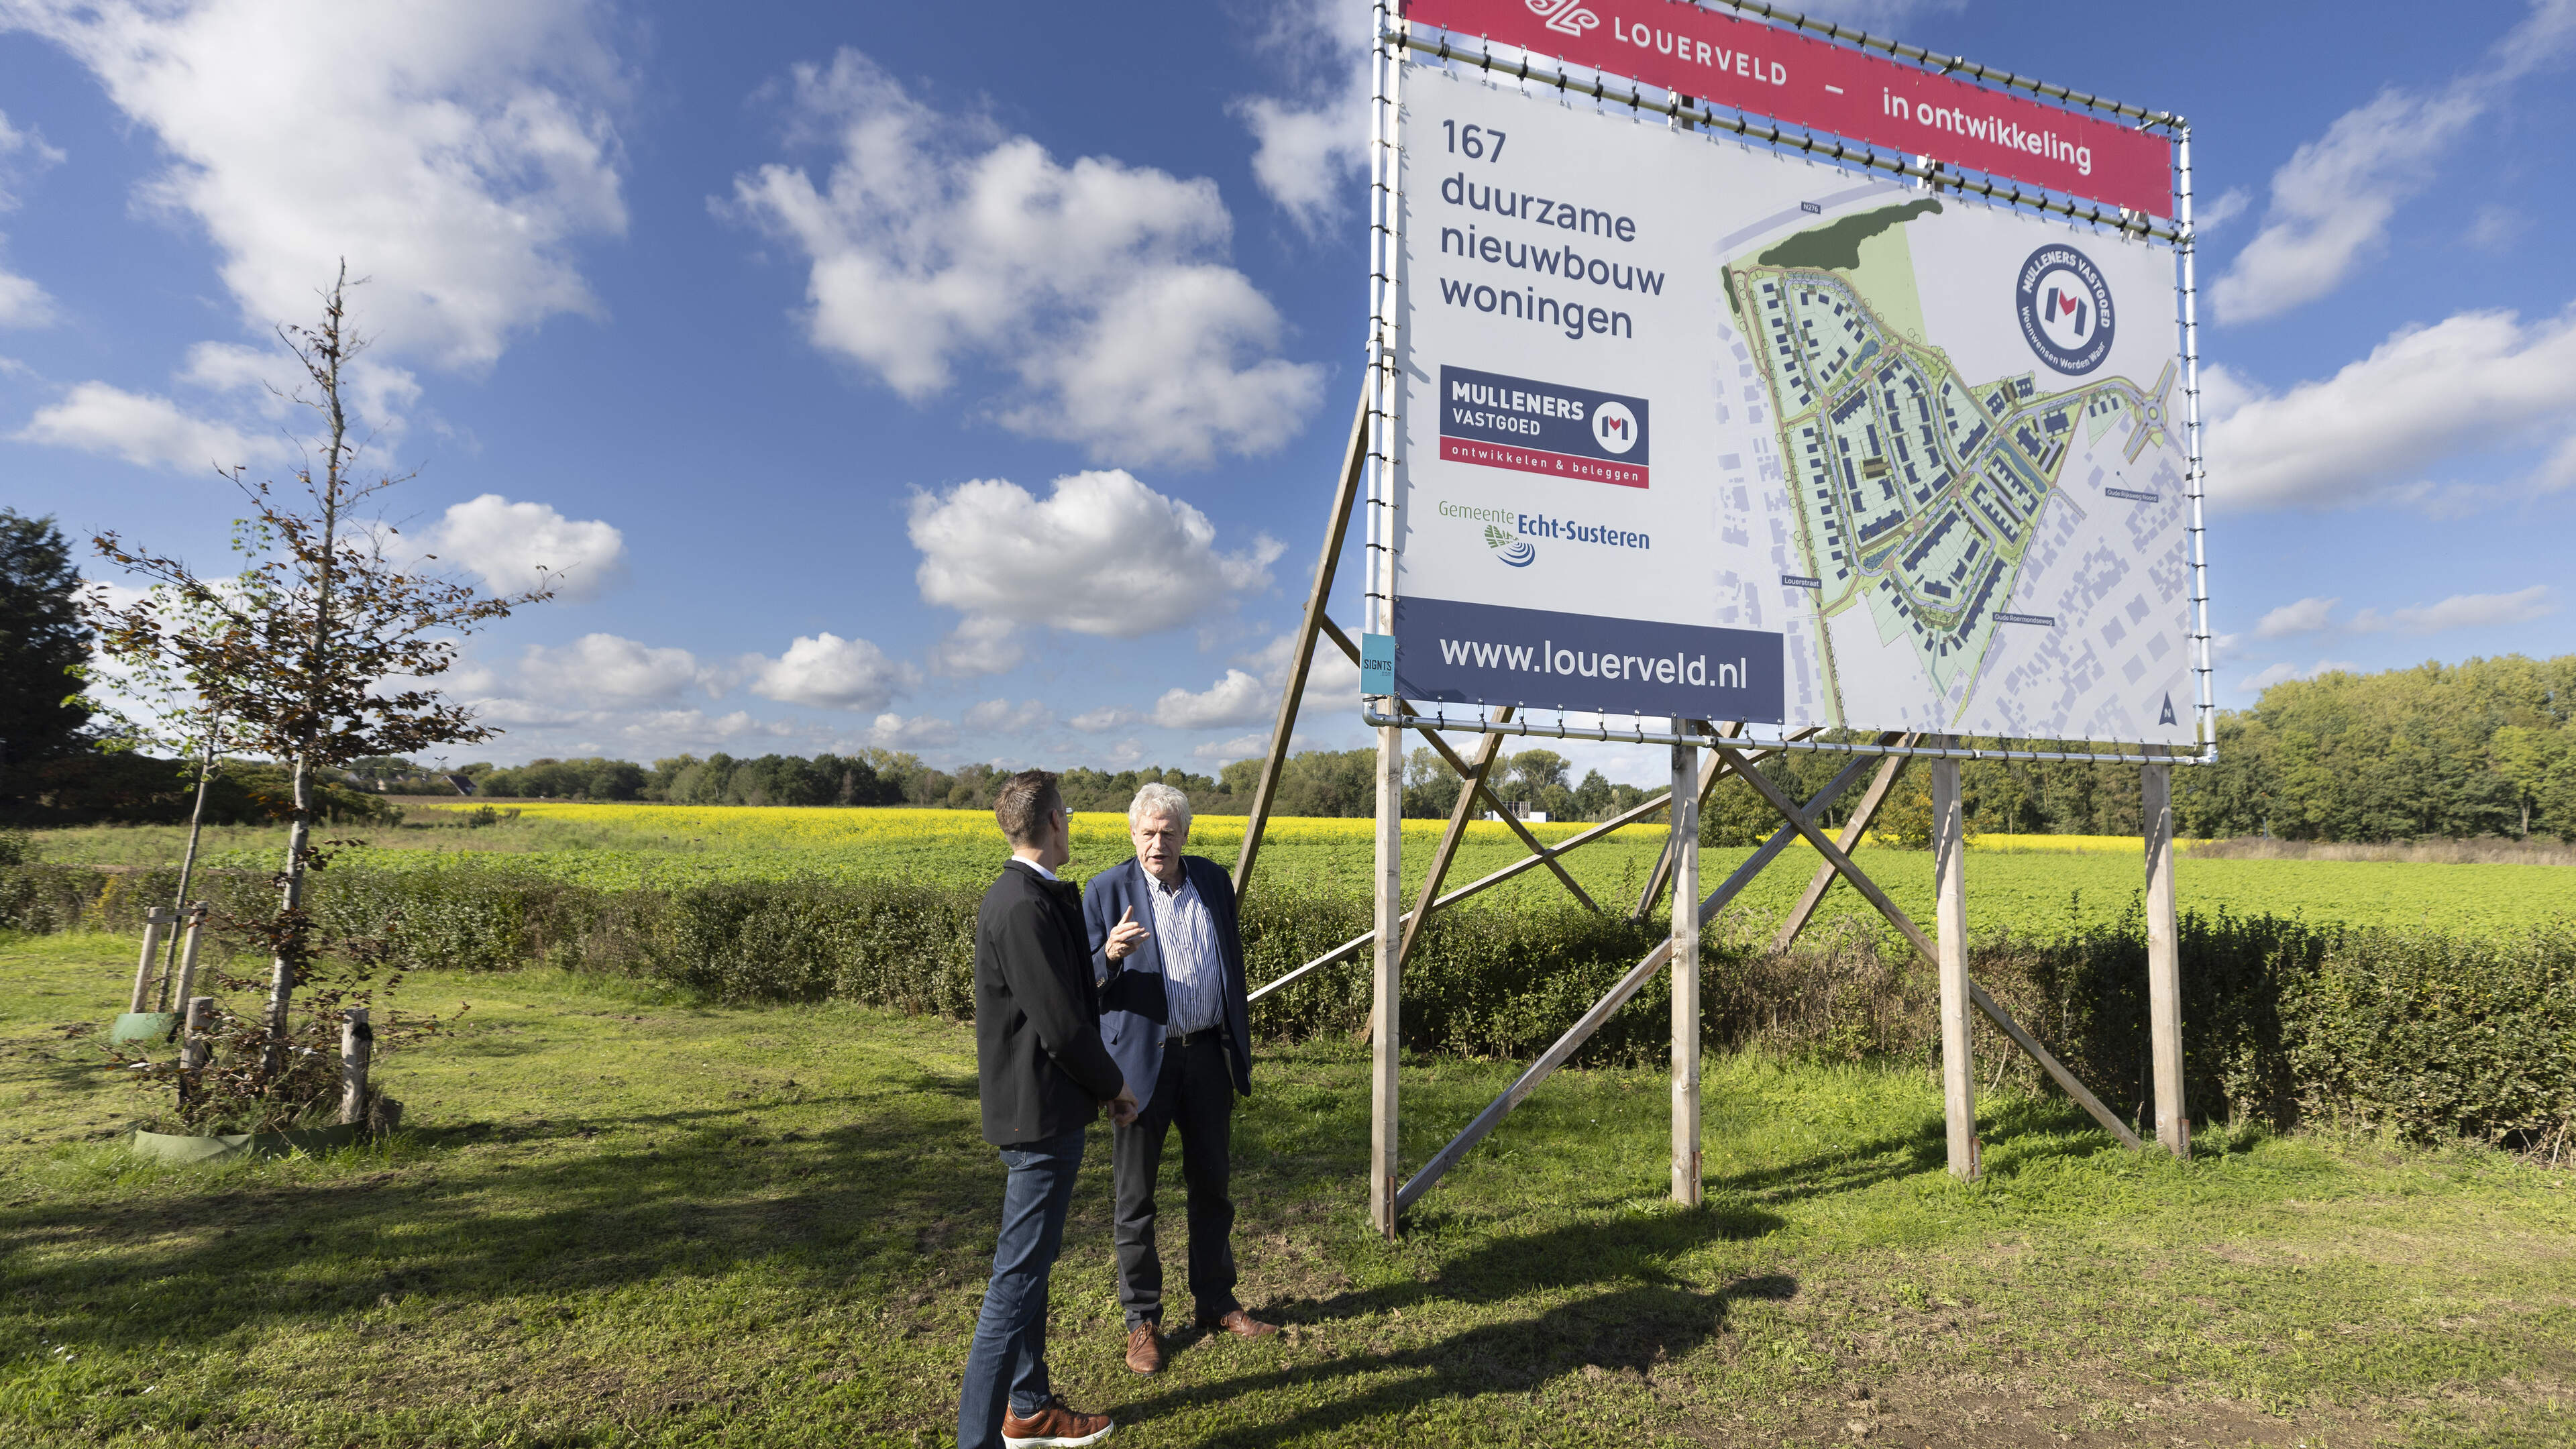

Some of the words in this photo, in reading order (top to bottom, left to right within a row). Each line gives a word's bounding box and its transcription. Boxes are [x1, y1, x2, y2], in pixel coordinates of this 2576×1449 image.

[1615, 17, 1786, 85] LOUERVELD
[1884, 87, 1909, 120] in
[1917, 103, 2092, 176] ontwikkeling
[1443, 119, 1506, 163] 167
[1441, 172, 1635, 241] duurzame
[1803, 203, 1819, 213] N276
[1442, 224, 1665, 296] nieuwbouw
[1440, 277, 1631, 339] woningen
[2023, 251, 2076, 294] MULLENERS
[2078, 259, 2110, 328] VASTGOED
[2022, 306, 2058, 365] Woonwensen
[2059, 356, 2090, 369] Worden
[2088, 341, 2106, 362] Waar
[1452, 381, 1584, 421] MULLENERS
[1453, 408, 1540, 435] VASTGOED
[1452, 446, 1547, 468] ontwikkelen
[1556, 460, 1564, 470] &
[1573, 462, 1638, 481] beleggen
[1439, 500, 1514, 524] Gemeente
[1518, 514, 1650, 549] Echt-Susteren
[1784, 577, 1820, 587] Louerstraat
[2010, 615, 2053, 626] Roermondseweg
[1364, 659, 1392, 672] SIGNTS
[1440, 639, 1746, 688] www.louerveld.nl
[2163, 708, 2171, 718] N
